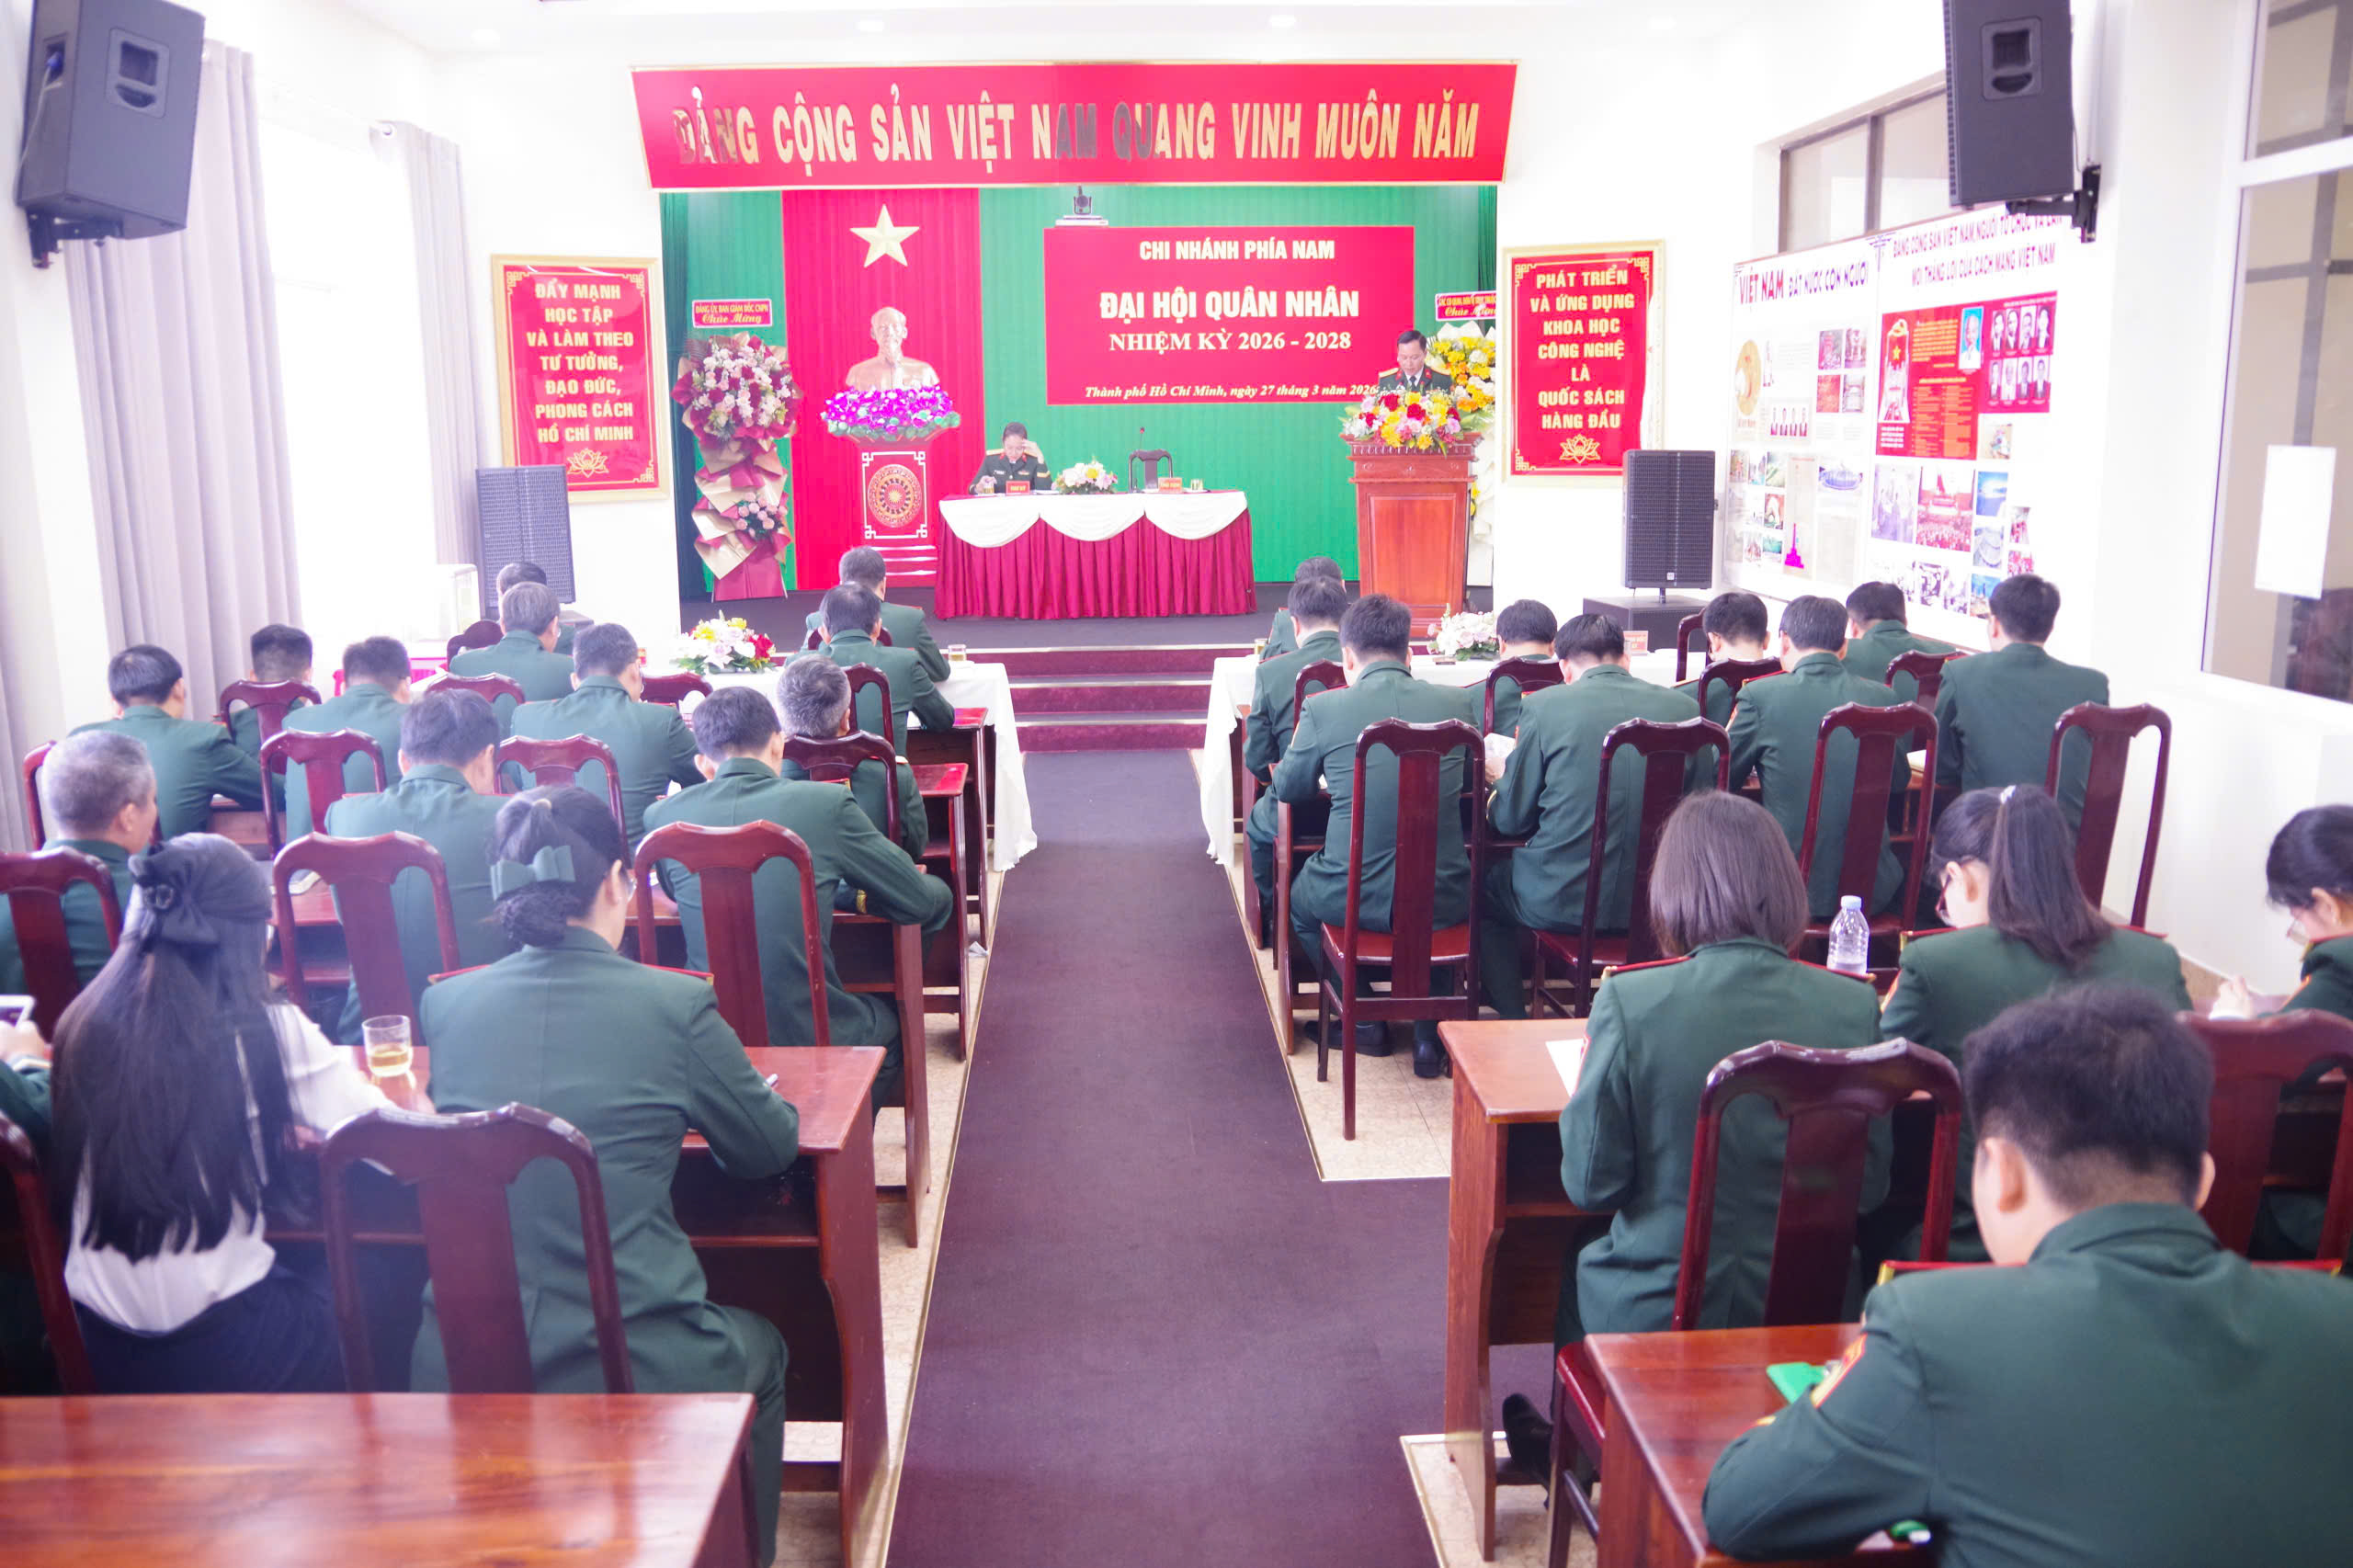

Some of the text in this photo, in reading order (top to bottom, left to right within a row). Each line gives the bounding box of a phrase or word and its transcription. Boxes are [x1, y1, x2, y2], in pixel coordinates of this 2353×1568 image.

[673, 83, 1480, 176] ĐẢNG CỘNG SẢN VIỆT NAM QUANG VINH MUÔN NĂM
[1140, 236, 1335, 260] CHI NHÁNH PHÍA NAM
[2038, 242, 2056, 265] NAM
[1536, 265, 1628, 289] PHÁT TRIỂN
[1761, 268, 1784, 301] NAM
[535, 278, 620, 302] ĐẨY MẠNH
[1099, 286, 1358, 324] ĐẠI HỘI QUÂN NHÂN
[1529, 293, 1634, 312] VÀ ỨNG DỤNG
[545, 305, 613, 325] HỌC TẬP
[527, 328, 633, 347] VÀ LÀM THEO
[1543, 318, 1620, 336] KHOA HỌC
[1109, 331, 1191, 355] NHIỆM
[1198, 328, 1233, 350] KỲ
[1239, 332, 1286, 350] 2026
[1304, 332, 1351, 349] 2028
[1538, 339, 1625, 360] CÔNG NGHỆ
[540, 351, 623, 372] TƯ TƯỞNG,
[1571, 363, 1590, 381] LÀ
[545, 377, 621, 398] ĐẠO ĐỨC,
[1086, 385, 1122, 398] Thành
[1123, 383, 1147, 399] phố
[1149, 383, 1167, 397] Hồ
[1169, 383, 1191, 397] Chí
[1192, 384, 1228, 399] Minh,
[1230, 385, 1257, 400] ngày
[1260, 385, 1274, 396] 27
[1277, 384, 1309, 399] tháng
[1312, 385, 1319, 396] 3
[1321, 384, 1347, 396] năm
[1538, 386, 1625, 406] QUỐC SÁCH
[535, 400, 633, 419] PHONG CÁCH
[1541, 409, 1620, 429] HÀNG ĐẦU
[538, 422, 633, 443] HỒ CHÍ MINH
